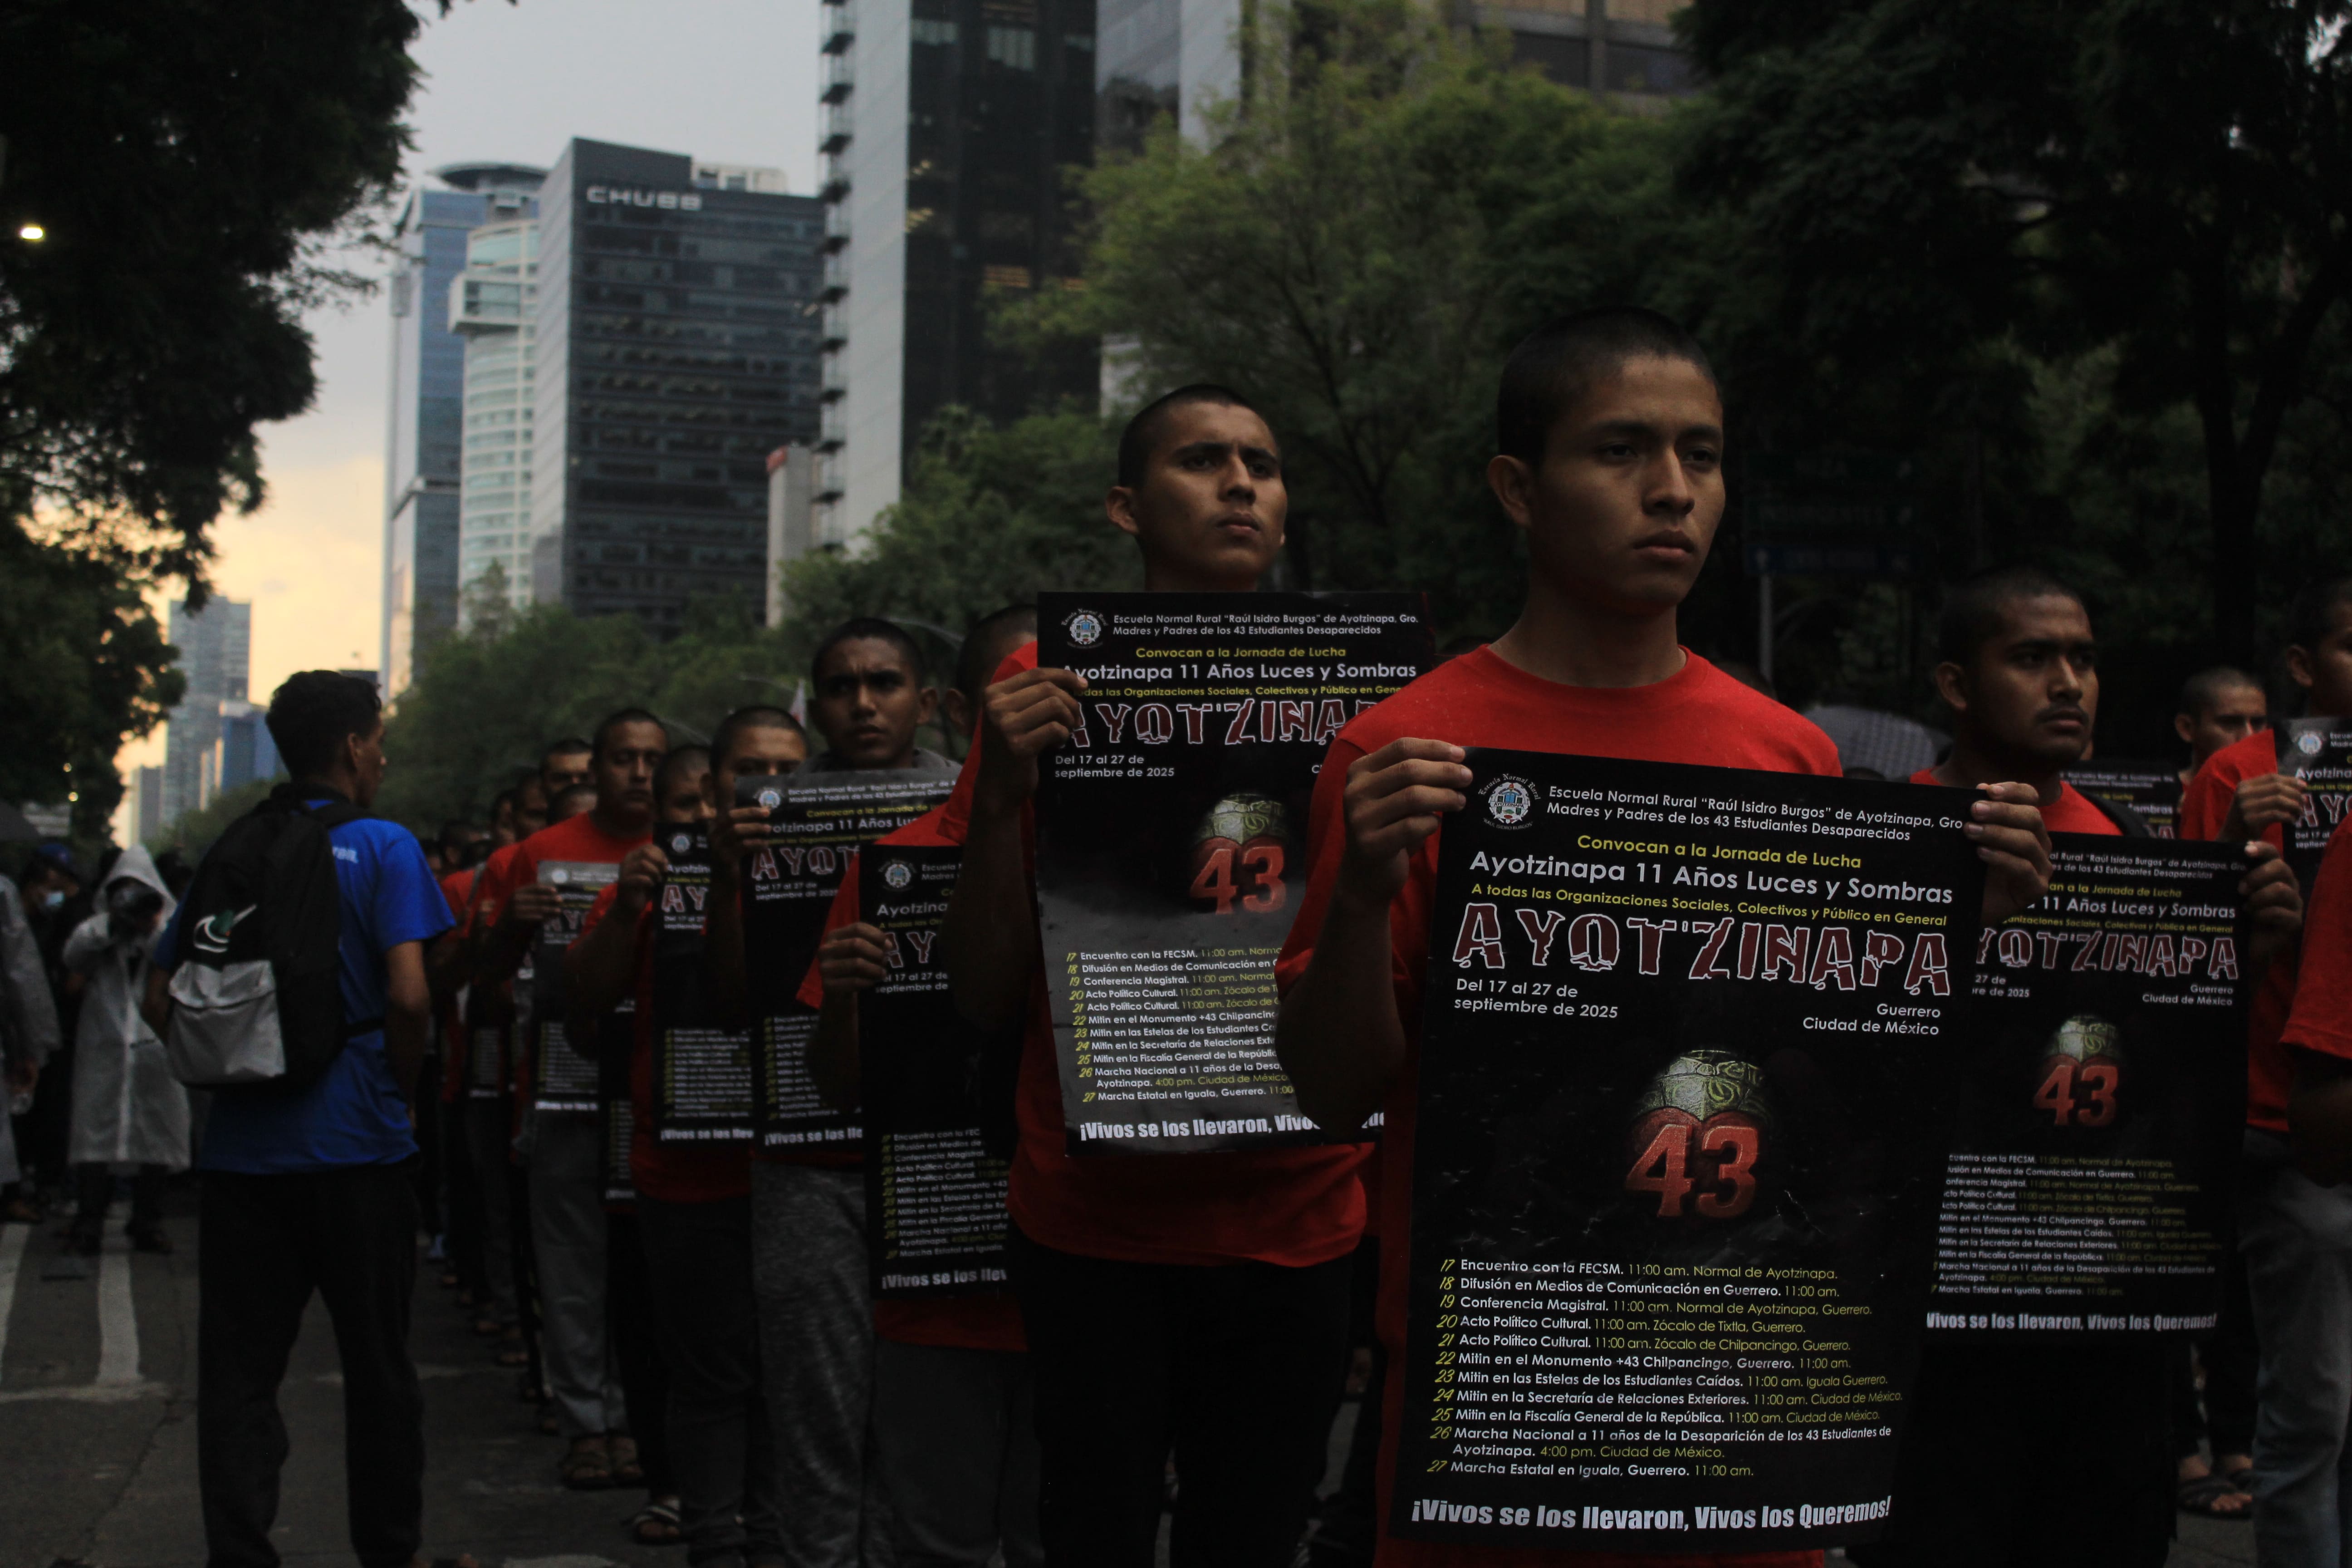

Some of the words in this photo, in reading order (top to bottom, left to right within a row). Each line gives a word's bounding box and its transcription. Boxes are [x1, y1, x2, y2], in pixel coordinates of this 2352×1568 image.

[587, 186, 702, 211] CHUBB
[1064, 665, 1172, 683] yotzinapa
[1180, 664, 1197, 679] 11
[1207, 663, 1254, 678] Años
[1261, 664, 1314, 678] Luces
[1319, 667, 1331, 681] y
[1337, 663, 1416, 678] Sombras
[1056, 755, 1075, 764] Del
[1079, 755, 1093, 764] 17
[1096, 755, 1107, 764] al
[1111, 755, 1125, 764] 27
[1128, 755, 1144, 764] de
[1055, 768, 1123, 779] septiembre
[1127, 768, 1143, 777] de
[1147, 768, 1174, 777] 2025
[1502, 773, 1528, 784] Normal
[1549, 786, 1603, 801] Escuela
[1607, 790, 1658, 805] Normal
[1663, 794, 1697, 808] Rural
[1741, 801, 1777, 814] Isidro
[1835, 808, 1852, 820] de
[1856, 810, 1934, 828] Ayotzinapa,
[1547, 802, 1600, 817] Madres
[1604, 809, 1612, 820] y
[1617, 808, 1664, 822] Padres
[1668, 811, 1686, 823] de
[1690, 813, 1710, 825] los
[1714, 815, 1730, 827] 43
[1734, 816, 1808, 833] Estudiantes
[1812, 823, 1910, 841] Desaparecidos
[1578, 835, 1669, 854] Convocan
[1675, 845, 1686, 855] a
[1691, 843, 1706, 857] la
[1712, 845, 1781, 862] Jornada
[1786, 851, 1808, 864] de
[1813, 853, 1861, 868] Lucha
[1190, 846, 1287, 915] 43
[1470, 851, 1625, 883] Ayotzinapa
[1637, 862, 1661, 883] 11
[1672, 866, 1738, 889] Años
[1747, 871, 1818, 894] Luces
[1825, 881, 1840, 900] y
[1847, 878, 1952, 903] Sombras
[877, 902, 948, 918] Ayotzina
[1471, 883, 1482, 894] A
[1487, 884, 1527, 897] todas
[1532, 887, 1551, 899] las
[1556, 889, 1667, 907] Organizaciones
[1671, 897, 1733, 913] Sociales,
[1737, 902, 1807, 917] Colectivos
[1811, 909, 1819, 920] y
[1823, 907, 1870, 921] Público
[1874, 913, 1891, 922] en
[1895, 912, 1947, 926] General
[2043, 896, 2059, 910] 11
[2066, 898, 2107, 913] Años
[2112, 901, 2154, 915] Luces
[2159, 906, 2167, 918] y
[2171, 903, 2236, 918] Sombras
[1456, 978, 1483, 991] Del
[1489, 980, 1507, 993] 17
[1512, 982, 1527, 994] al
[1531, 983, 1552, 995] 27
[1556, 985, 1578, 998] de
[2190, 984, 2233, 994] Guerrero
[1454, 998, 1548, 1014] septiembre
[1553, 1003, 1575, 1015] de
[1579, 1004, 1618, 1018] 2025
[2142, 994, 2179, 1004] Ciudad
[2181, 995, 2194, 1004] de
[2197, 996, 2232, 1005] México
[1877, 1003, 1940, 1018] Guerrero
[1803, 1017, 1857, 1031] Ciudad
[1862, 1020, 1881, 1032] de
[1885, 1020, 1939, 1035] México
[2033, 1064, 2119, 1127] 43
[1080, 1122, 1135, 1141] ¡Vivos
[1137, 1123, 1159, 1137] se
[1162, 1121, 1190, 1137] los
[1192, 1117, 1272, 1136] llevaron,
[1623, 1123, 1759, 1219] 43
[953, 1270, 977, 1284] los
[1441, 1259, 1455, 1272] 17
[1461, 1259, 1529, 1272] Encuentro
[1533, 1264, 1559, 1273] con
[1563, 1262, 1575, 1273] la
[1579, 1263, 1623, 1274] FECSM.
[1629, 1264, 1660, 1275] 11:00
[1664, 1267, 1689, 1276] am.
[1694, 1265, 1741, 1277] Normal
[1745, 1267, 1762, 1278] de
[1766, 1268, 1838, 1281] Ayotzinapa.
[1440, 1276, 1455, 1290] 18
[1461, 1277, 1511, 1290] Difusión
[1515, 1282, 1532, 1290] en
[1536, 1280, 1583, 1292] Medios
[1587, 1281, 1603, 1292] de
[1607, 1282, 1700, 1294] Comunicación
[1704, 1286, 1720, 1295] en
[1723, 1284, 1781, 1296] Guerrero.
[1786, 1286, 1814, 1297] 11:00
[1818, 1289, 1839, 1297] am.
[1436, 1314, 1458, 1328] 20
[1460, 1315, 1490, 1327] Acto
[1494, 1315, 1538, 1328] Político
[1541, 1317, 1591, 1329] Cultural.
[1595, 1318, 1624, 1330] 11:00
[1627, 1322, 1650, 1330] am.
[1653, 1319, 1695, 1331] Zócalo
[1698, 1321, 1715, 1332] de
[1718, 1321, 1749, 1333] Tixtla,
[1752, 1321, 1805, 1333] Guerrero.
[1926, 1312, 1966, 1328] Vivos
[1969, 1315, 1988, 1329] se
[1991, 1313, 2015, 1329] los
[2019, 1313, 2083, 1330] llevaron,
[2087, 1314, 2126, 1329] Vivos
[2129, 1315, 2151, 1330] los
[2154, 1313, 2217, 1332] Queremos!
[1426, 1460, 1447, 1472] 27
[1450, 1461, 1505, 1474] Marcha
[1510, 1464, 1554, 1475] Estatal
[1558, 1467, 1574, 1475] en
[1579, 1464, 1623, 1478] Iguala,
[1628, 1465, 1689, 1476] Guerrero.
[1696, 1465, 1726, 1476] 11:00
[1730, 1467, 1754, 1476] am.
[1411, 1499, 1493, 1524] ¡Vivos
[1499, 1507, 1530, 1526] se
[1536, 1505, 1576, 1528] los
[1583, 1506, 1689, 1532] llevaron,
[1695, 1506, 1756, 1529] Vivos
[1761, 1506, 1794, 1528] los
[1799, 1495, 1891, 1529] Queremos!
